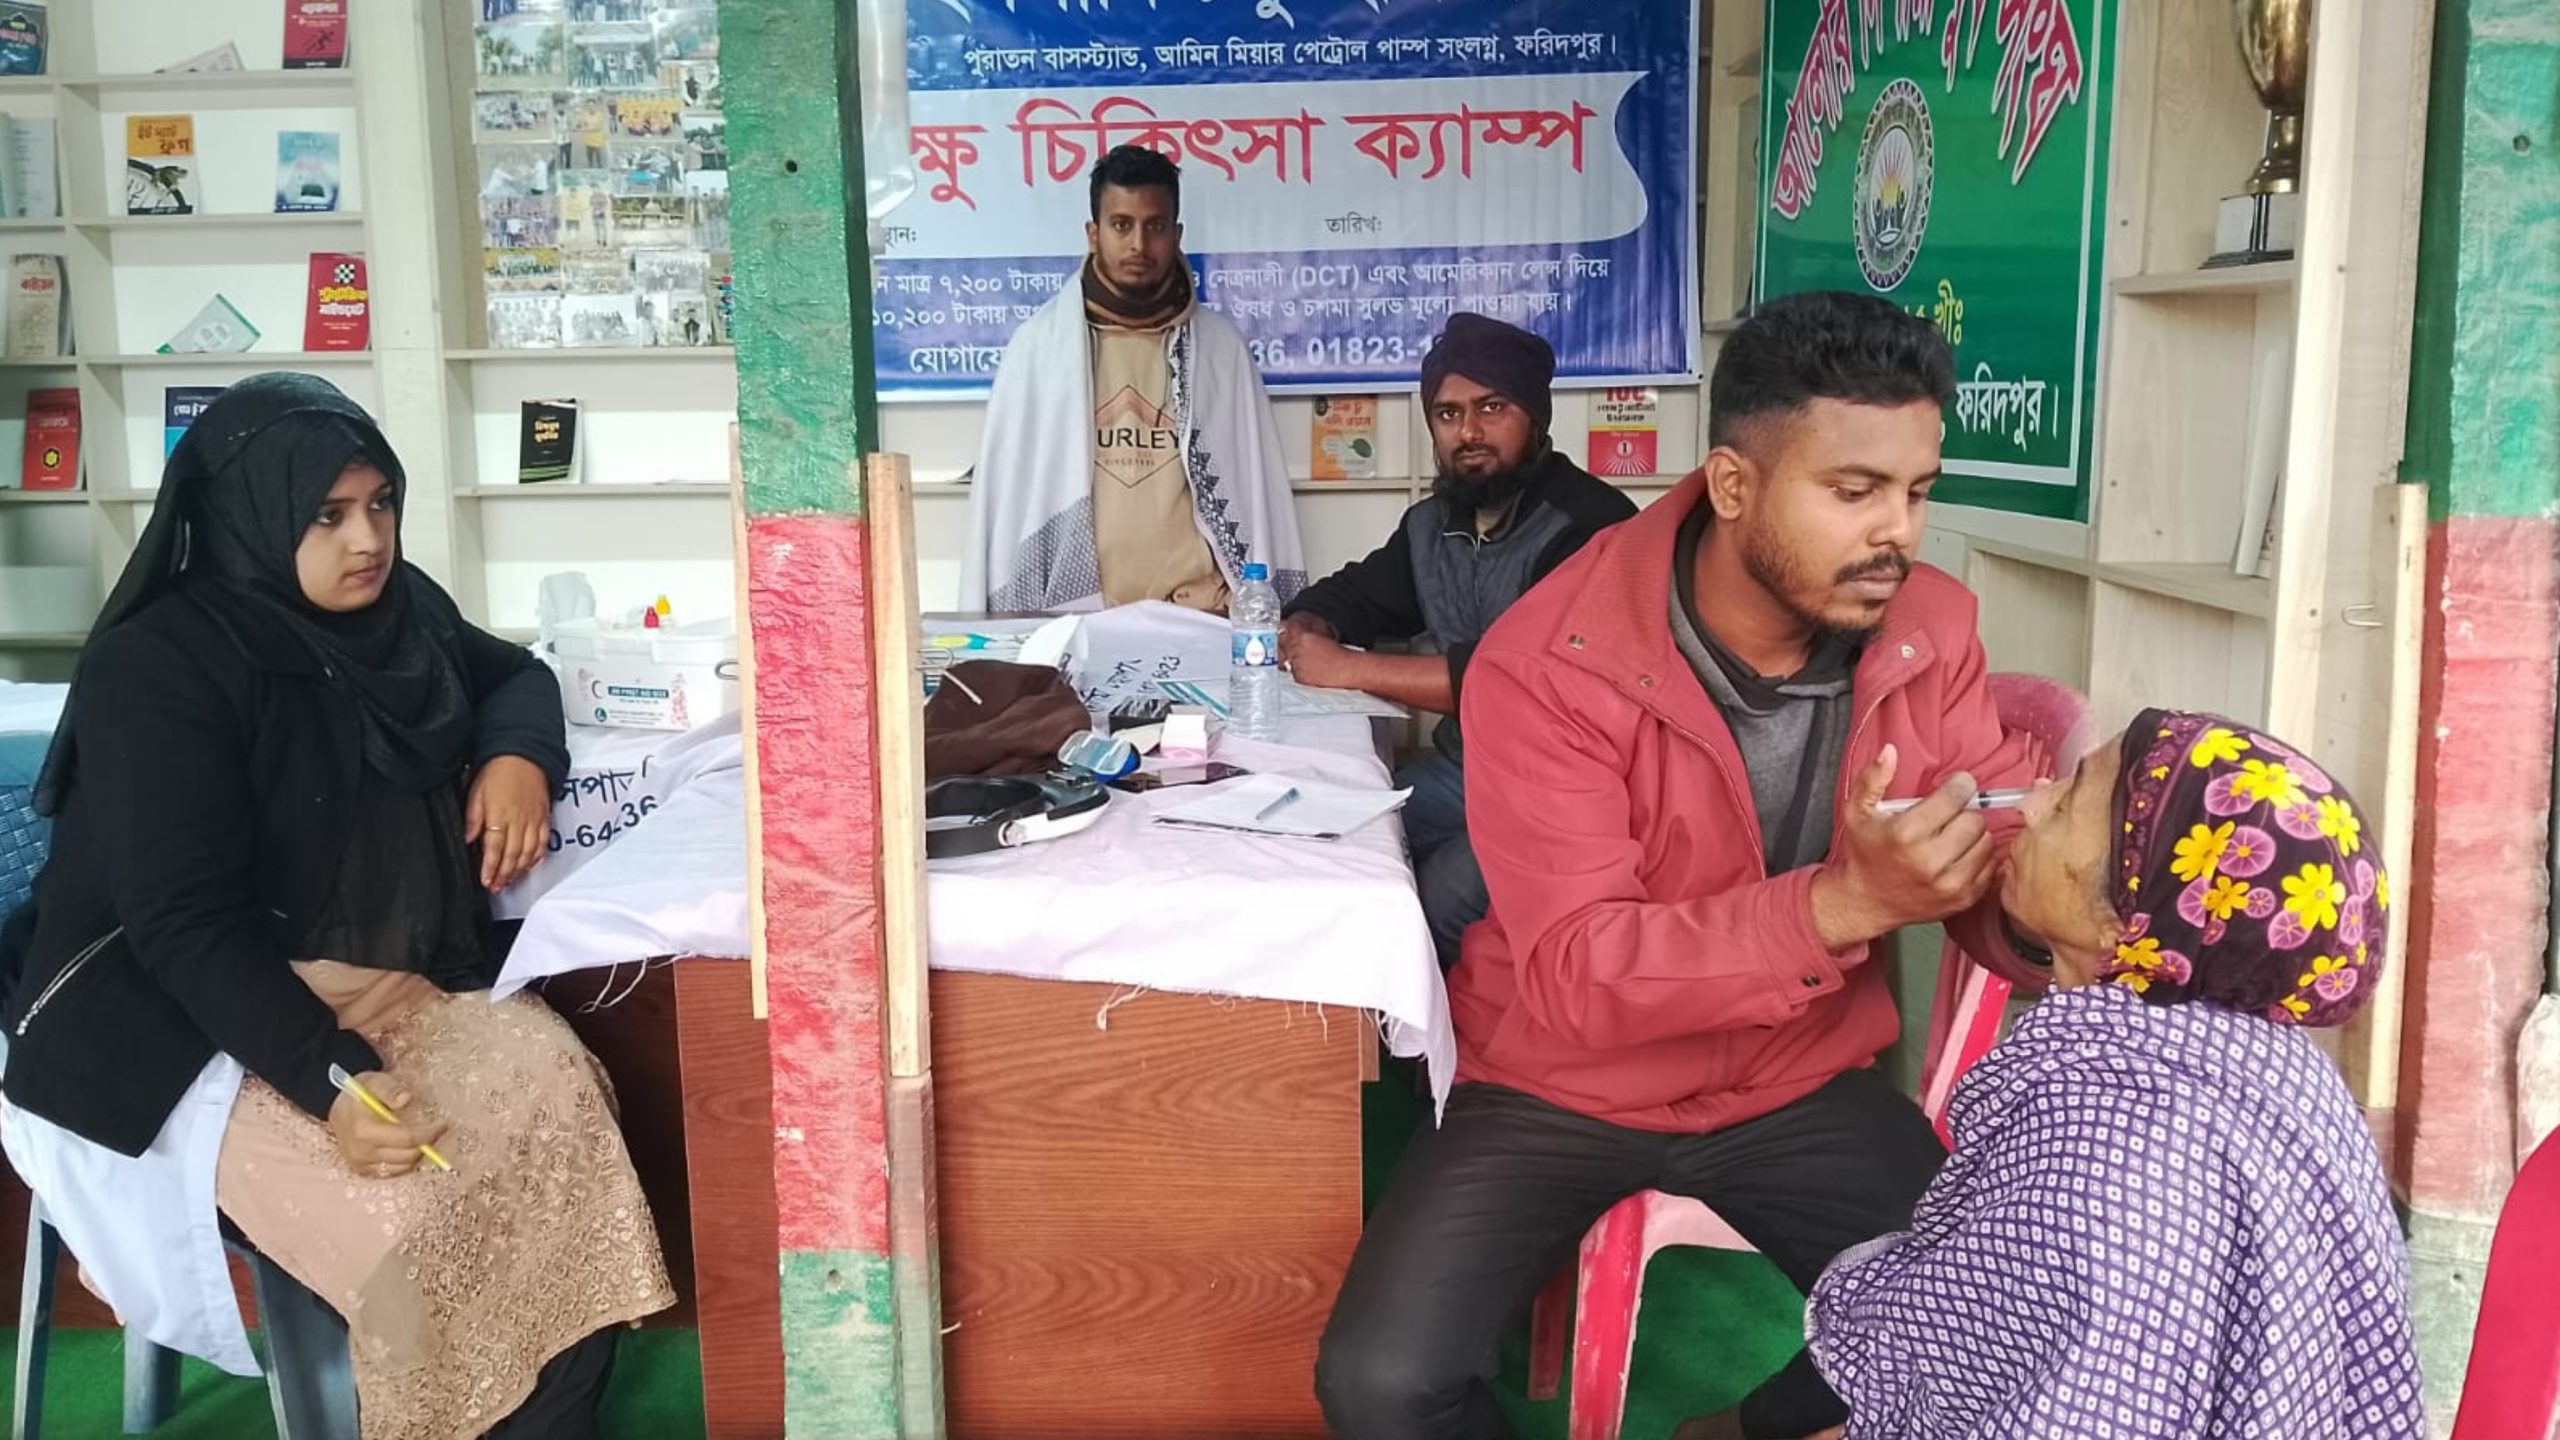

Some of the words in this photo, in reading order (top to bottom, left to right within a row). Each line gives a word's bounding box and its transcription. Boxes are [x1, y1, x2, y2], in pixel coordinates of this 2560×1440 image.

[963, 47, 1035, 80] পুরাতন
[1155, 40, 1220, 68] আমিন
[1225, 38, 1285, 66] মিয়ার
[1294, 36, 1367, 66] পেট্রোল
[1376, 36, 1430, 63] পাম্প
[1342, 100, 1598, 181] ক্যাম্প
[895, 274, 932, 294] মাত্র
[939, 274, 1003, 298] ৭,২০০
[1290, 264, 1361, 291] (DCT)
[1367, 265, 1409, 286] এবং
[1412, 257, 1516, 284] আমেরিকান
[1097, 427, 1180, 449] URLEY
